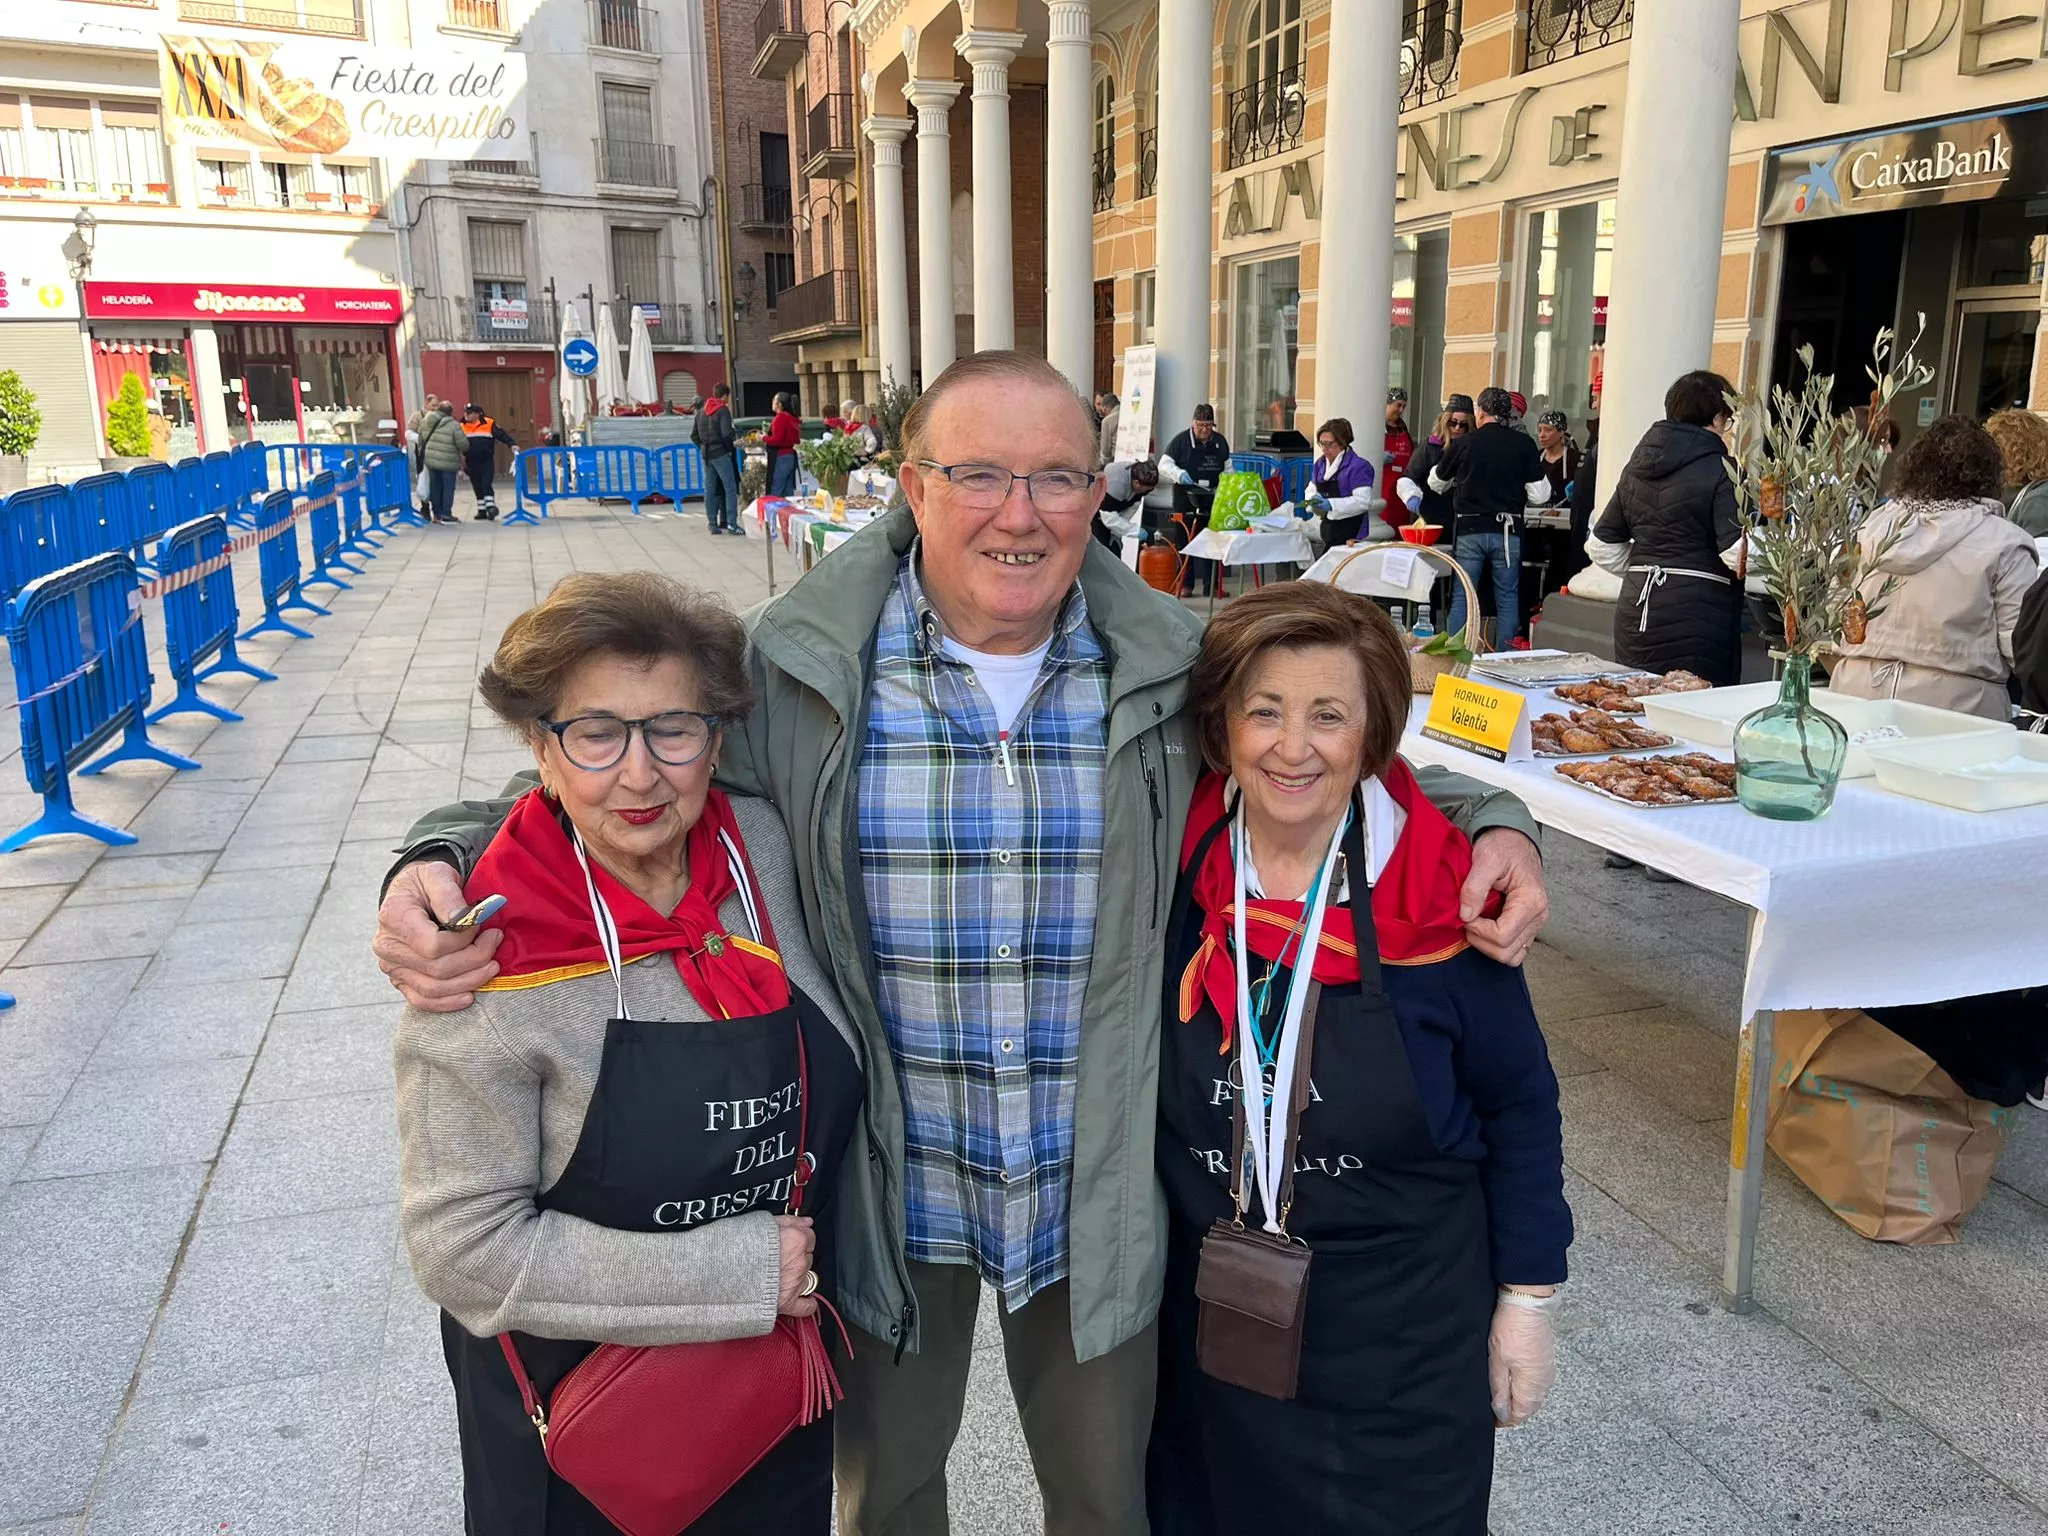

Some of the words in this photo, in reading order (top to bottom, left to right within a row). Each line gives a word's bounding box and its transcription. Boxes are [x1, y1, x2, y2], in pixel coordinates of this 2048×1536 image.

[331, 56, 438, 96] Fiesta
[449, 62, 505, 98] del
[361, 99, 516, 149] Crespillo
[1851, 132, 2013, 190] CaixaBank
[102, 294, 153, 306] HELADERÍA
[335, 298, 392, 311] HORCHATERÍA
[1454, 688, 1498, 709] HORNILLO
[1452, 706, 1488, 732] Valentia
[1475, 745, 1502, 758] BARBASTRO
[731, 1131, 796, 1176] DEL
